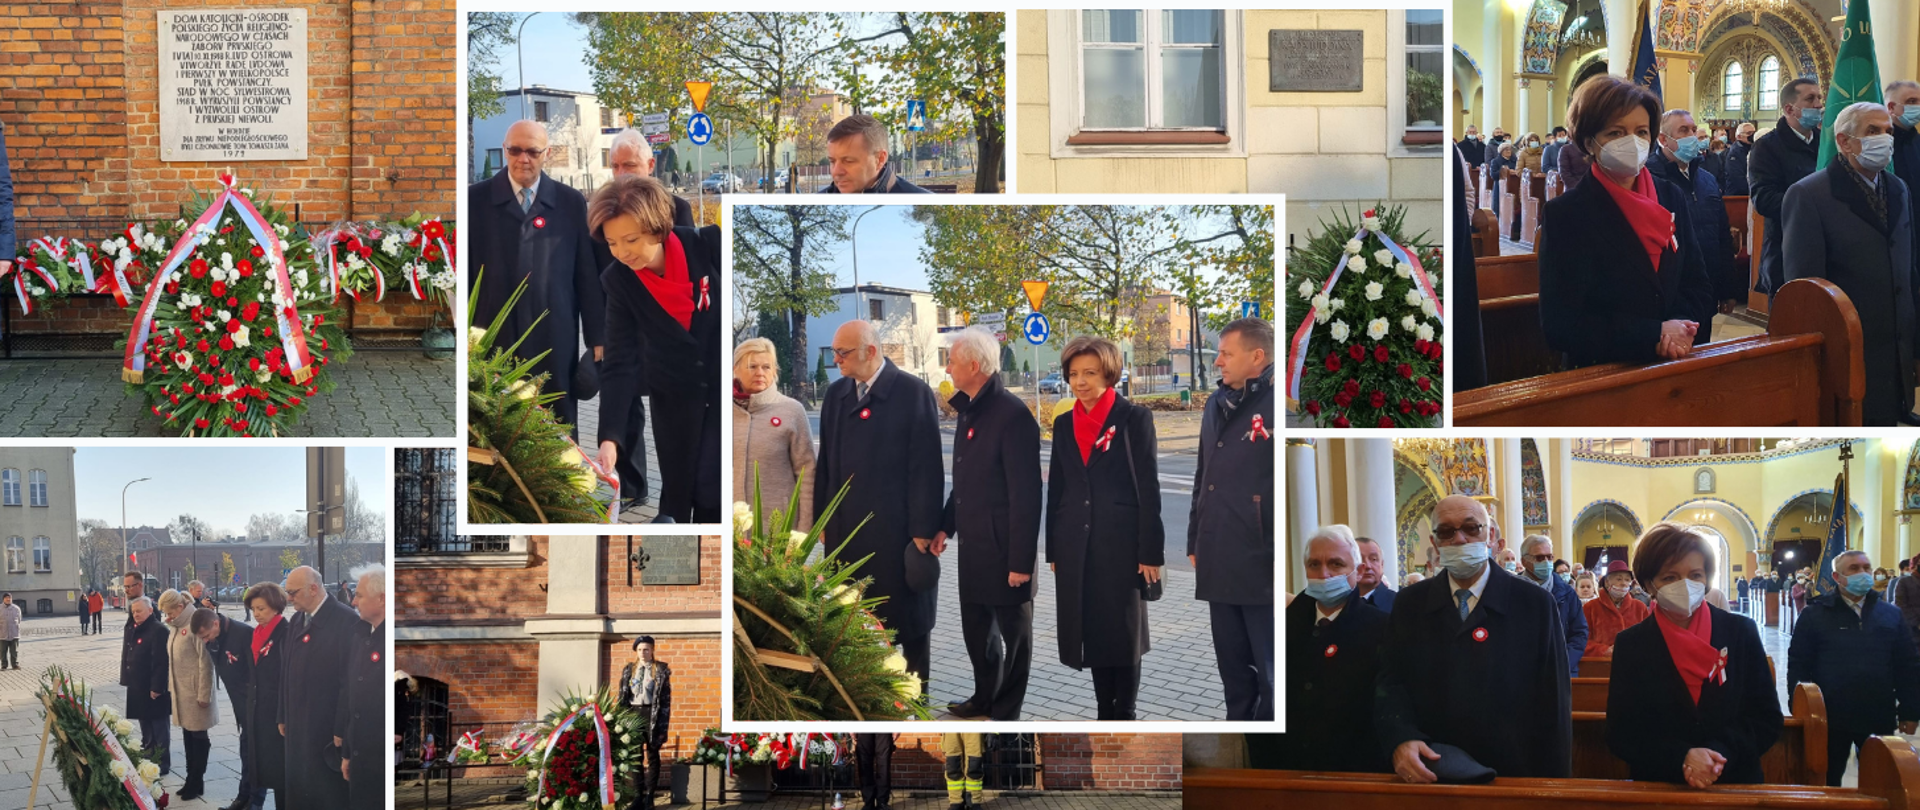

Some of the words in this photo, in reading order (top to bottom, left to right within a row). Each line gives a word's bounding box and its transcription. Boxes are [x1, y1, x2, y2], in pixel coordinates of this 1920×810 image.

[174, 14, 198, 23] DOM
[172, 24, 218, 32] POLSKIEGO
[176, 32, 240, 42] NARODOWEGO
[252, 32, 288, 40] CZASACH
[250, 50, 293, 59] OSTROWA
[180, 70, 216, 78] PIERWSZY
[230, 68, 290, 78] WIELKOPOLSCE
[210, 87, 230, 96] NOC
[195, 106, 240, 114] WYZWOLILI
[238, 114, 274, 124] NIEWOLI.
